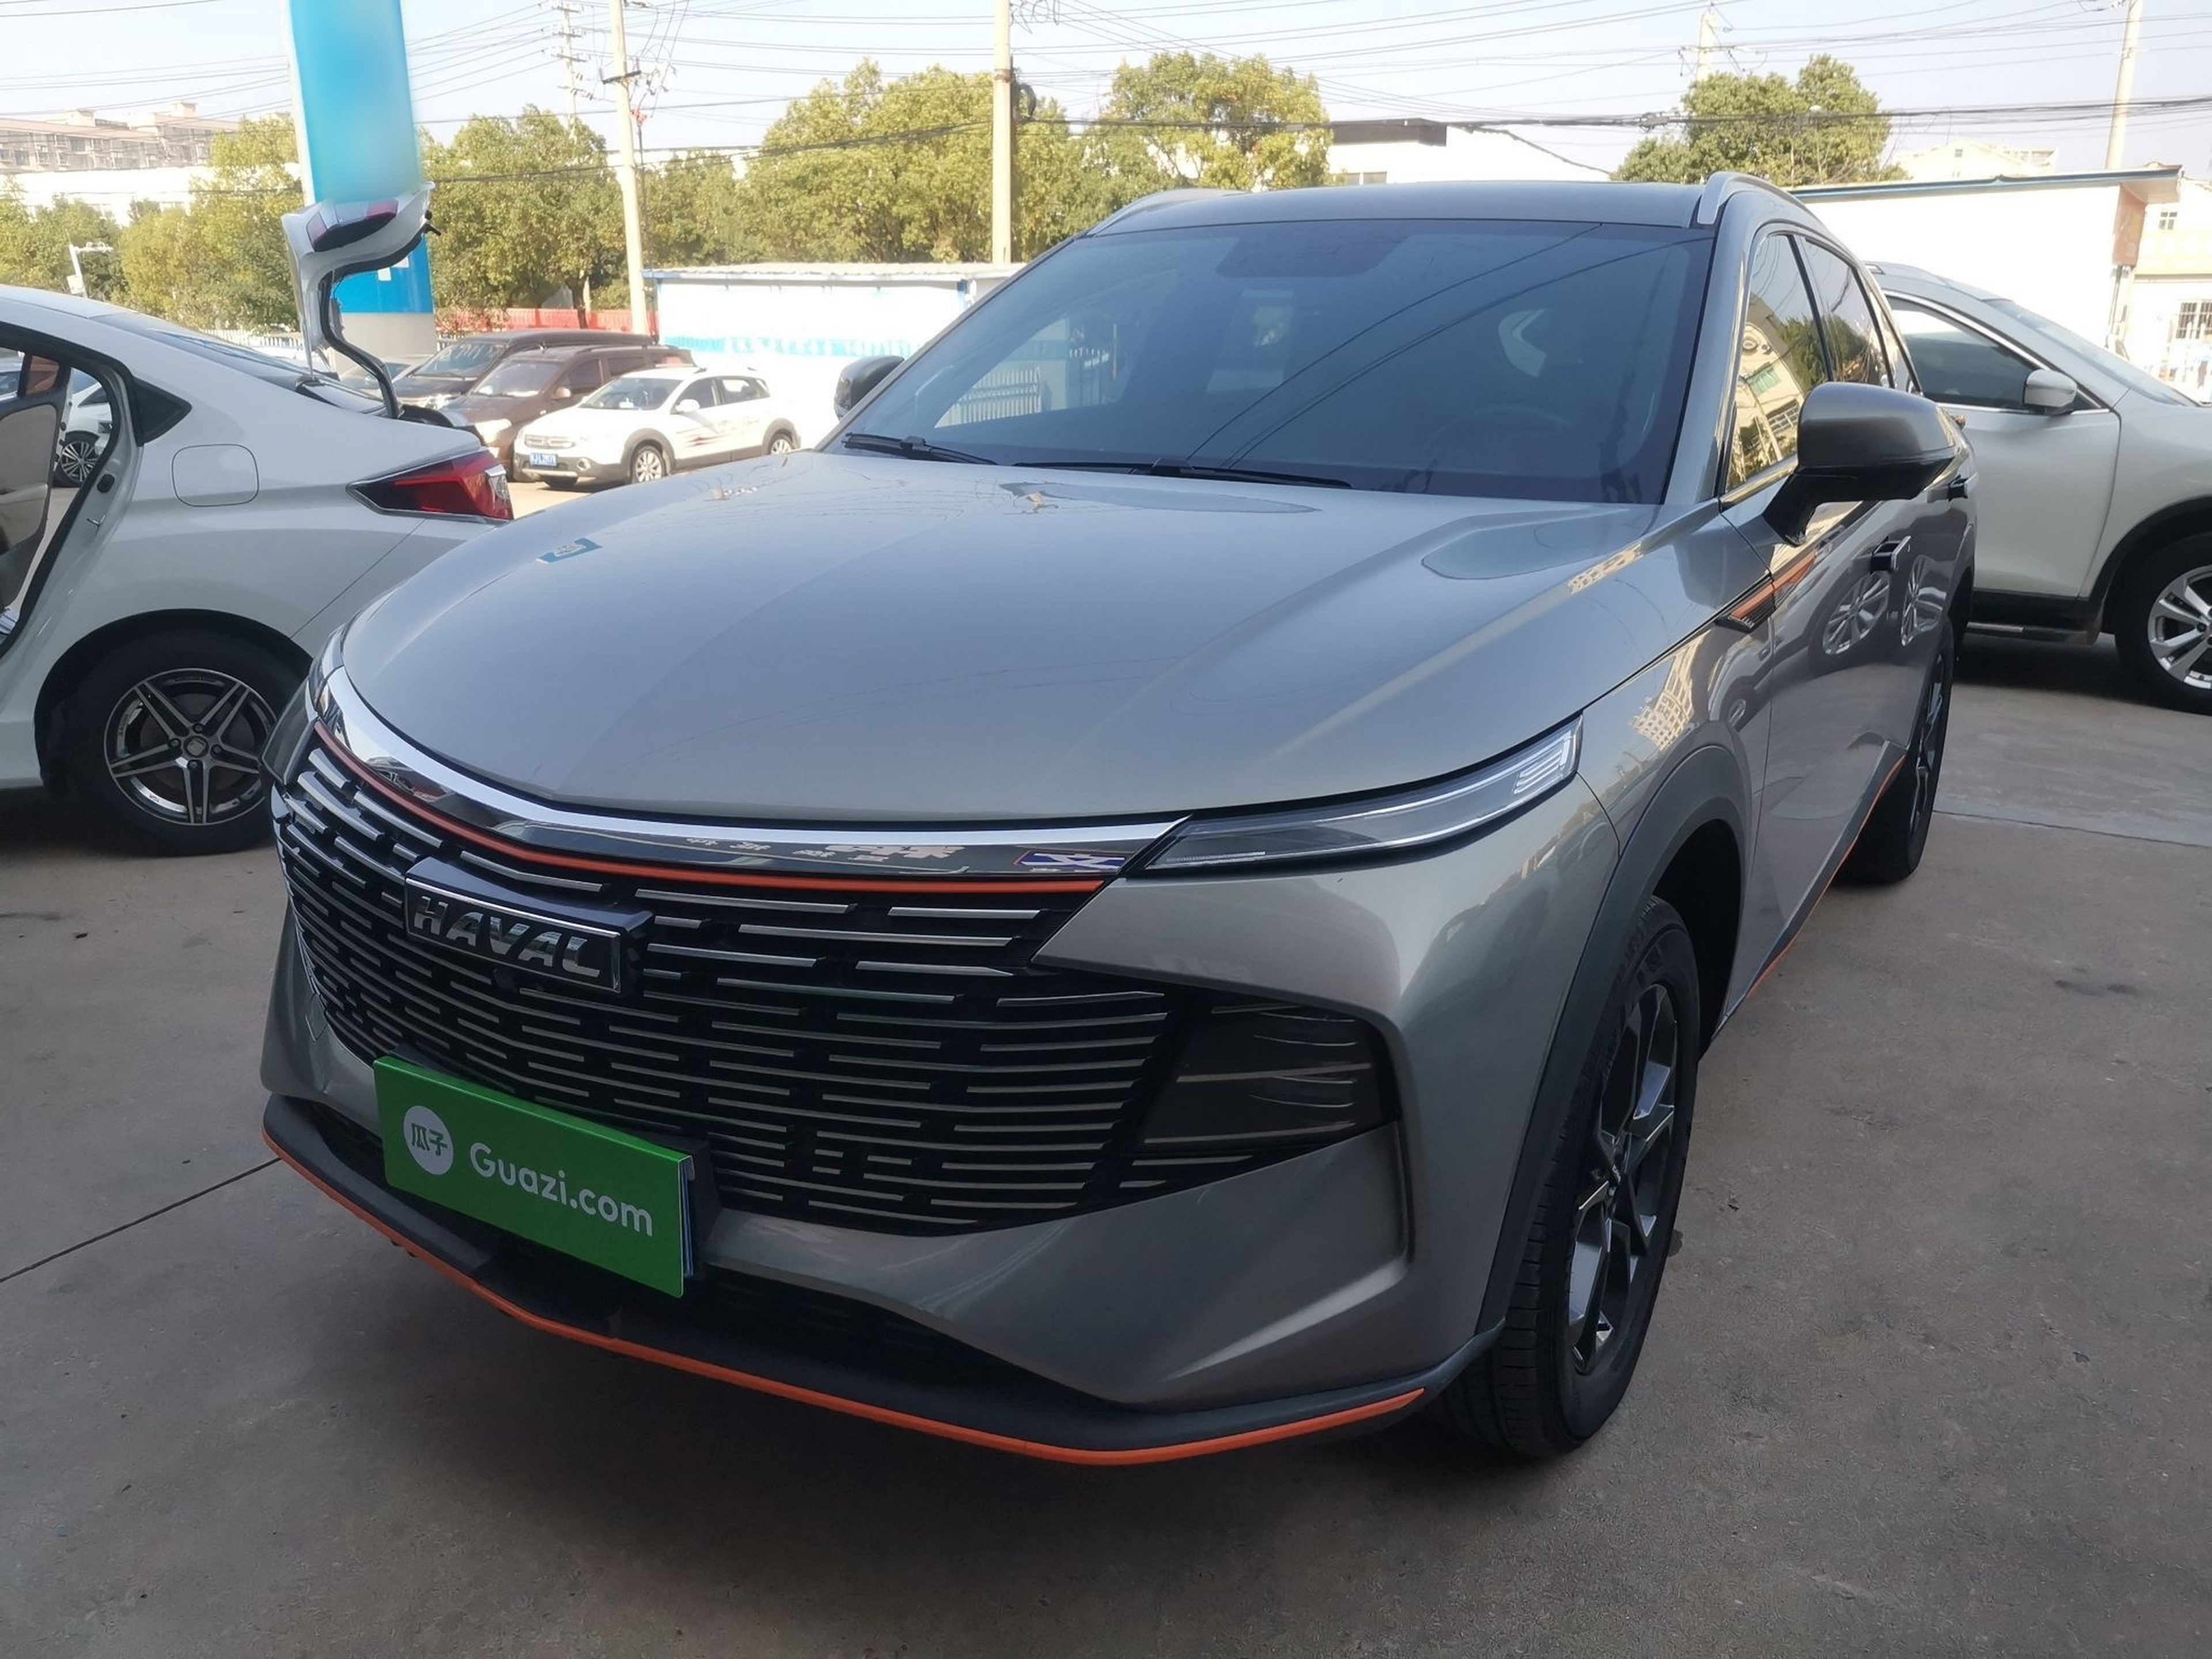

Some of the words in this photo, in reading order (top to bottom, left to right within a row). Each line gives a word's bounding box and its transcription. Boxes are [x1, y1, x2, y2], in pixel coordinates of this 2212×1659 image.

[414, 895, 600, 978] HAVAL
[411, 1122, 448, 1156] 瓜子
[469, 1142, 653, 1237] Guazi.com
